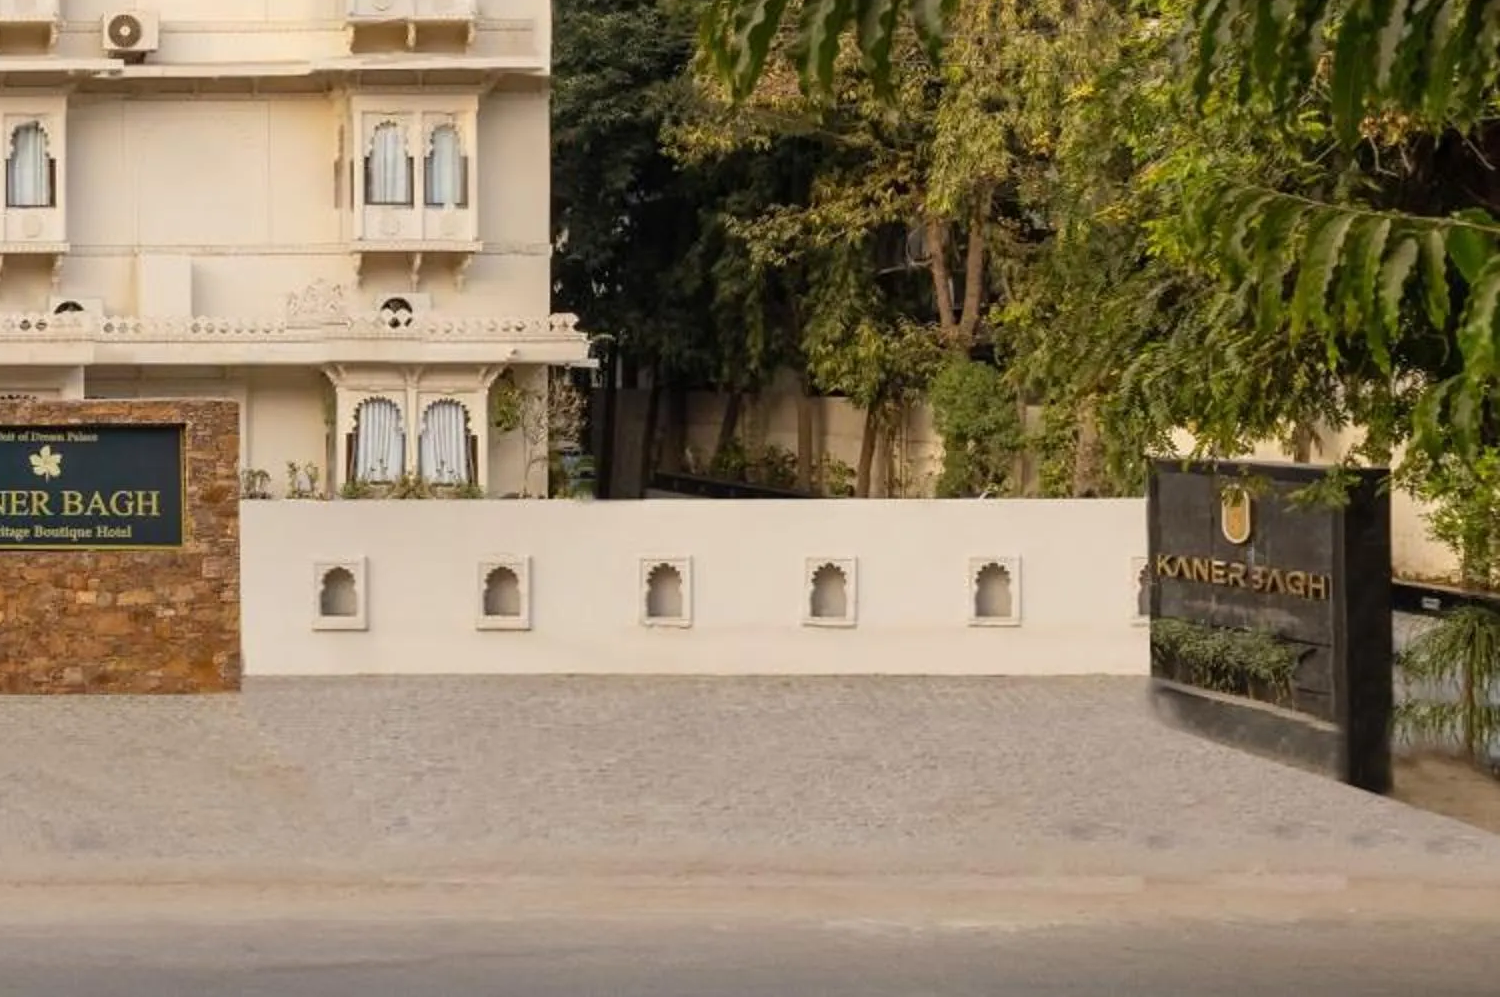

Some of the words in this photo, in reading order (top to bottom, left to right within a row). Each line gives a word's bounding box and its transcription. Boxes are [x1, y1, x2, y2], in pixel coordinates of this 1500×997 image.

[17, 431, 30, 442] of
[66, 431, 99, 442] Palace
[60, 490, 161, 516] BAGH
[34, 525, 93, 542] Boutique
[96, 525, 132, 538] Hotel
[1156, 554, 1246, 588] KANER
